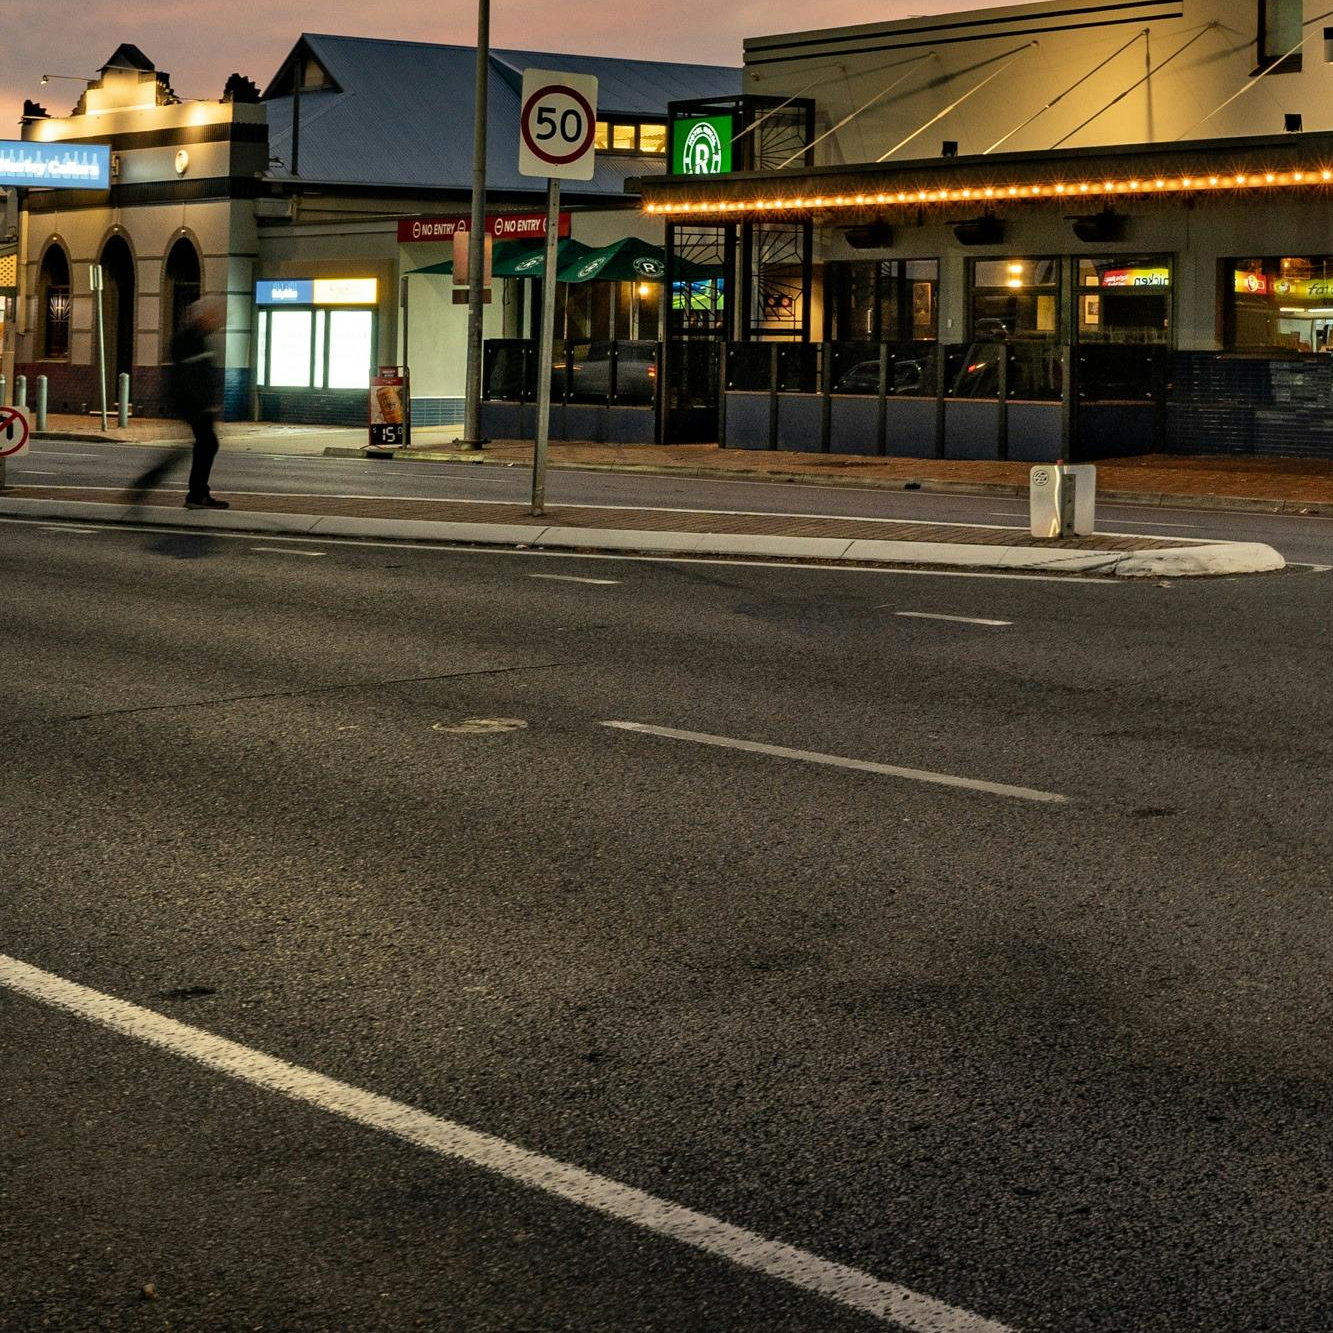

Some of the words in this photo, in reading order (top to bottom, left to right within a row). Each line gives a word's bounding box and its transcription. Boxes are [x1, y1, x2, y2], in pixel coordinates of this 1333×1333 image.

[535, 106, 583, 144] 50
[695, 144, 709, 174] R
[421, 225, 433, 236] NO
[433, 223, 455, 236] ENTRY
[504, 221, 516, 233] NO
[518, 219, 541, 232] ENTRY
[643, 263, 656, 272] R
